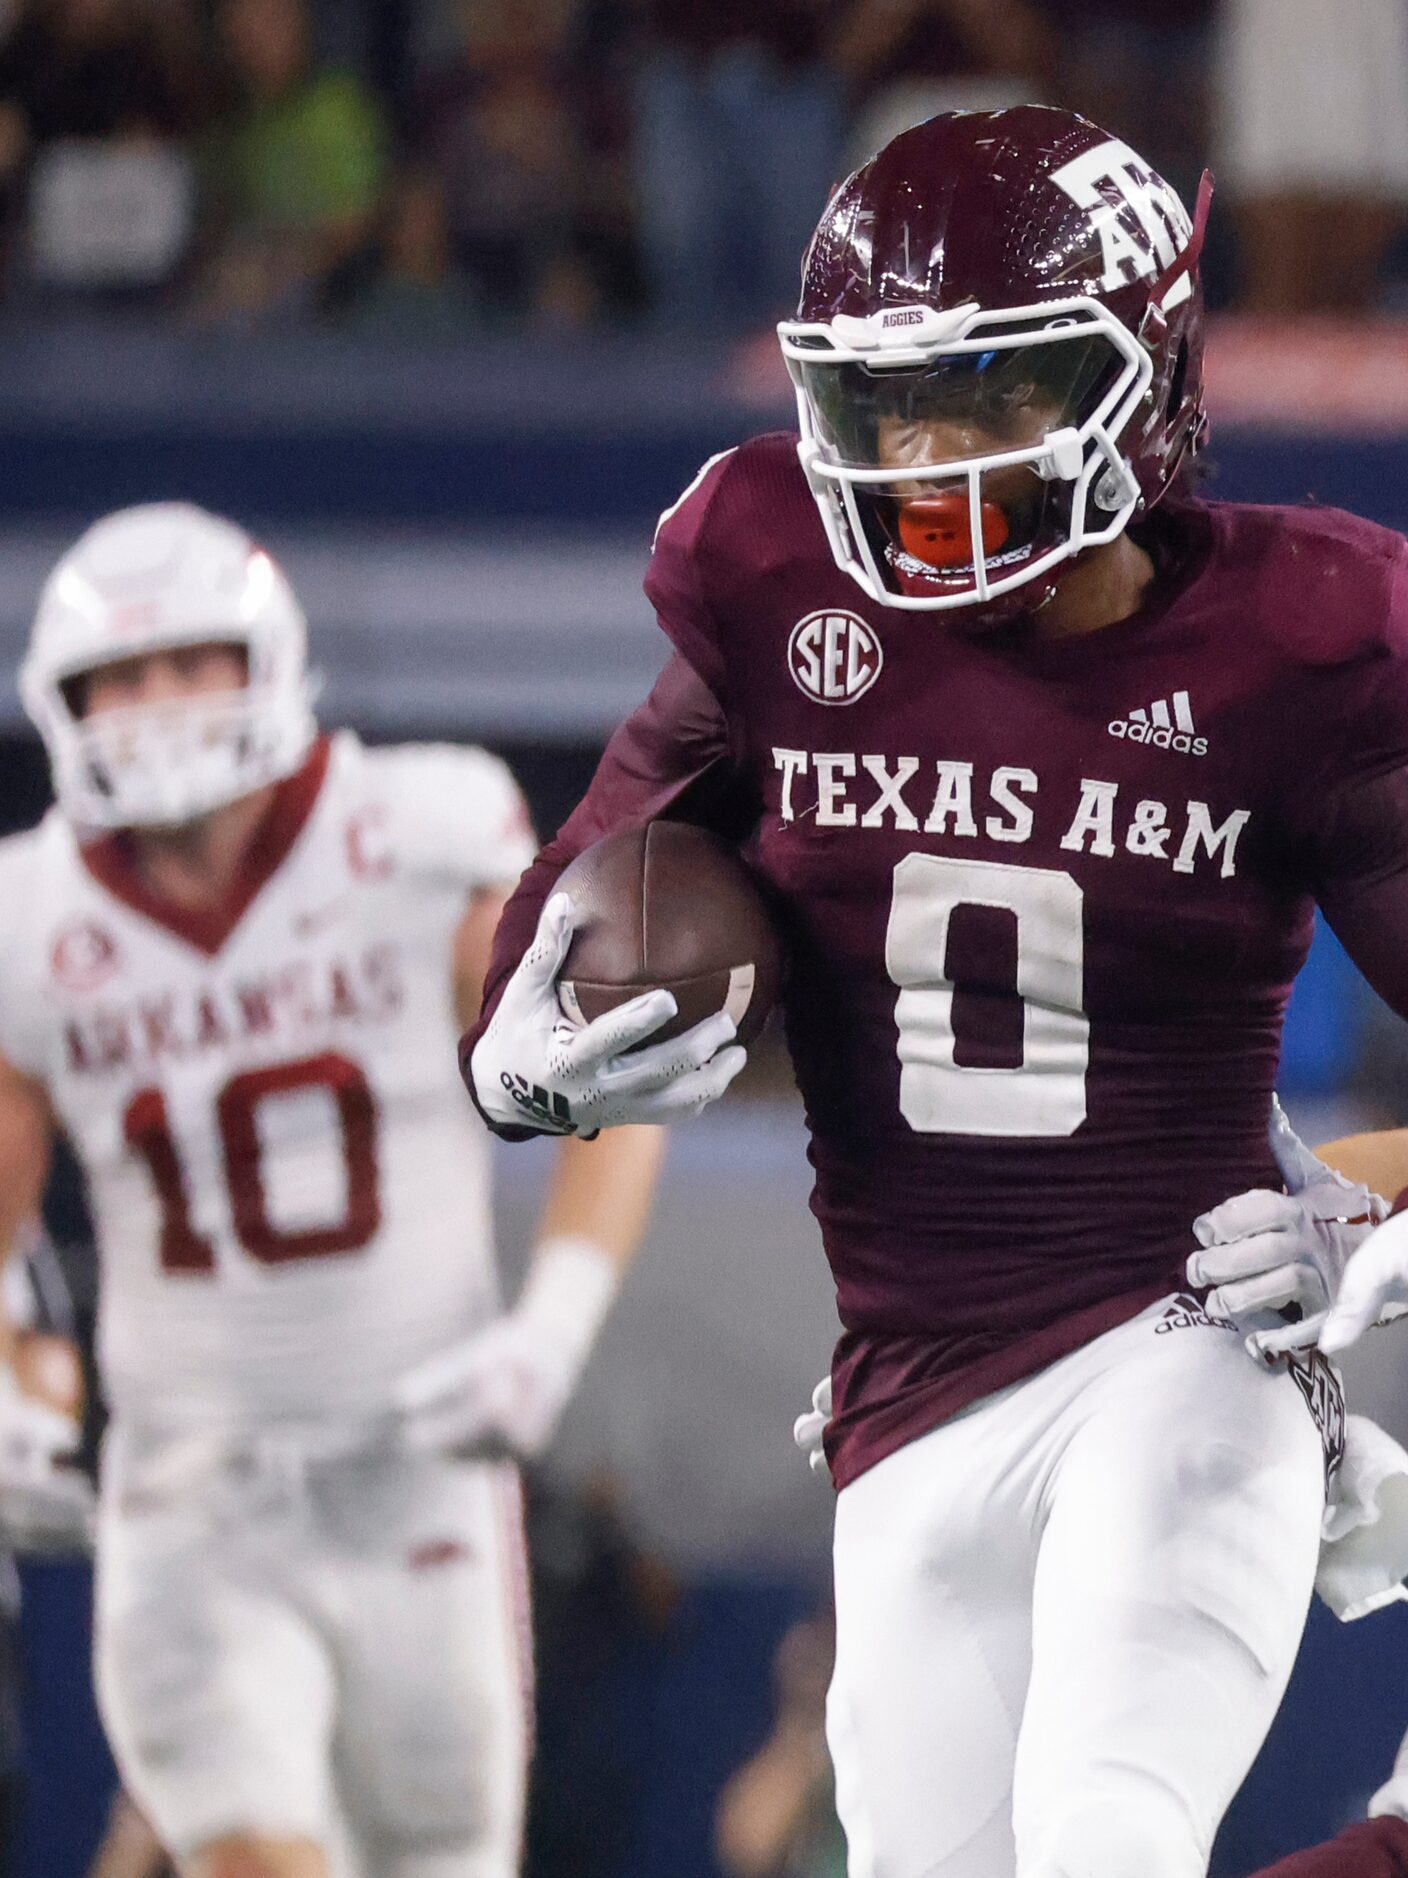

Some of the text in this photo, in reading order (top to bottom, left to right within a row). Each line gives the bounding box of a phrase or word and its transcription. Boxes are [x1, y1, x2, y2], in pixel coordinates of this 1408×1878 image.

[882, 311, 924, 328] AGGIES
[796, 614, 870, 698] SEC
[1108, 717, 1209, 756] adidas
[772, 747, 1250, 878] TEXAS A&M
[886, 852, 1090, 1137] 0
[124, 1050, 382, 1277] 10
